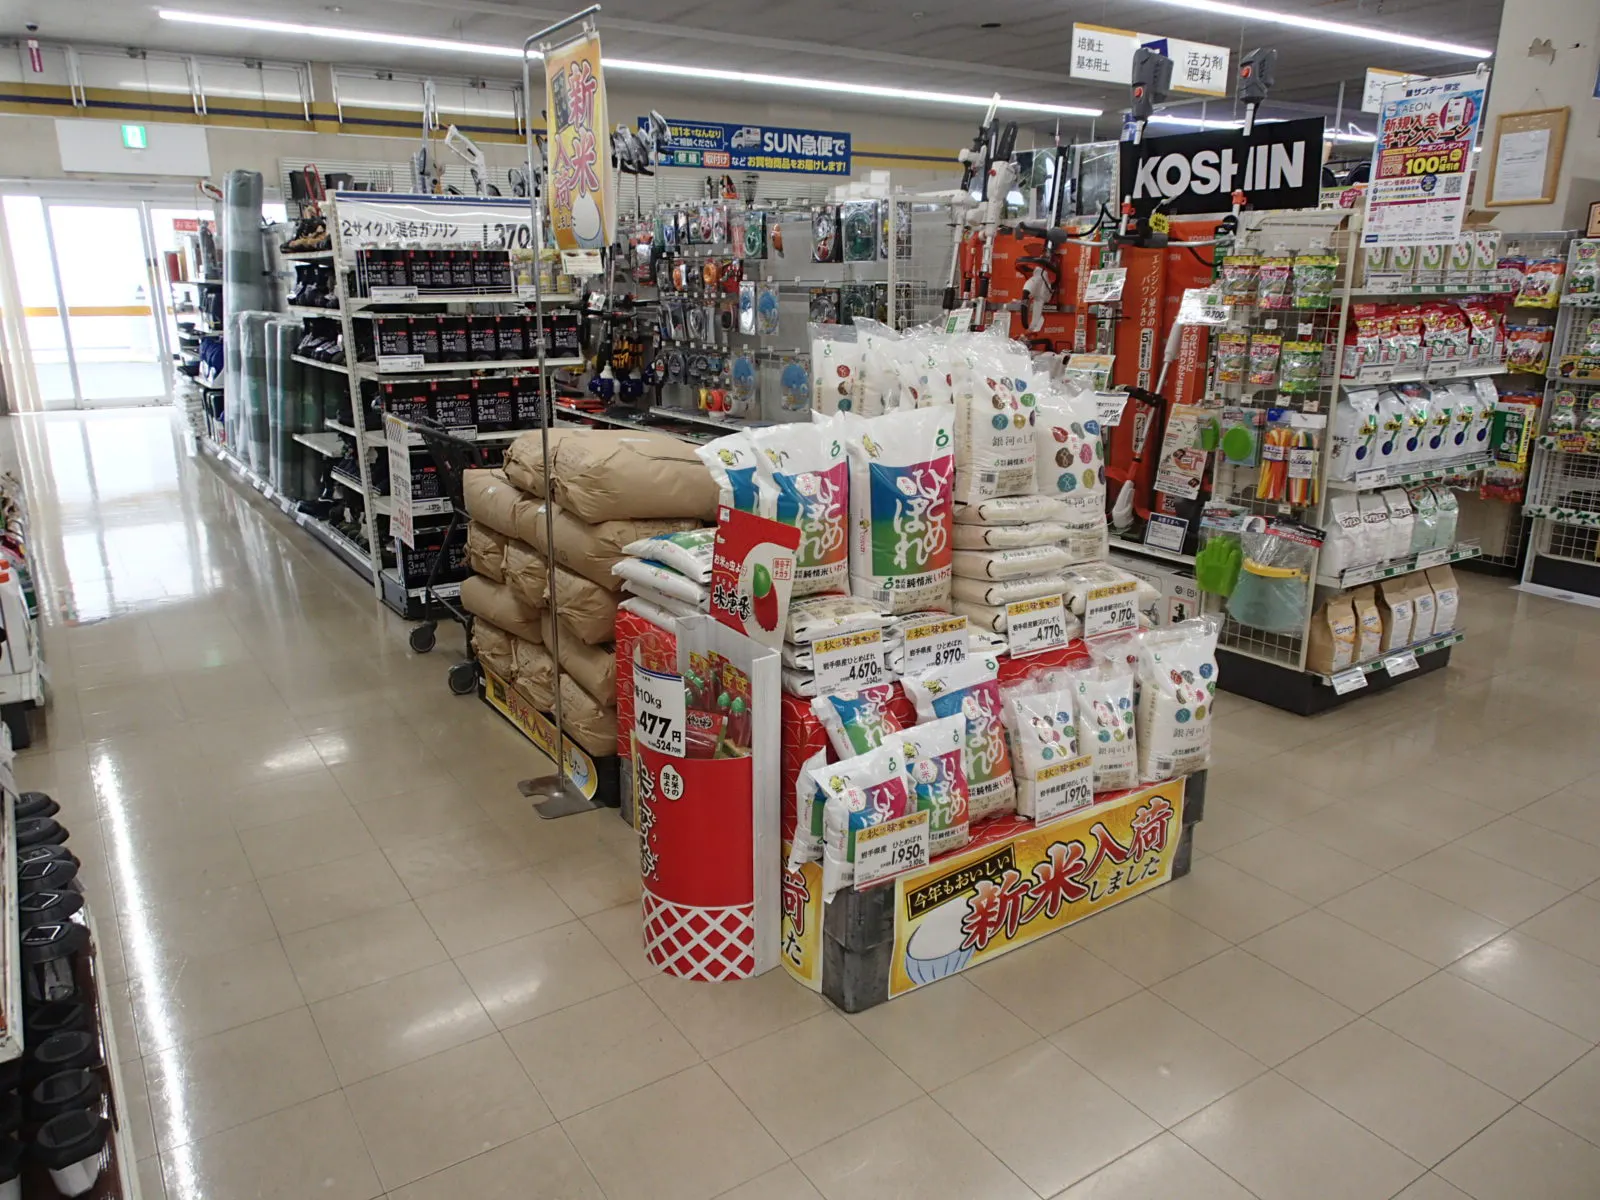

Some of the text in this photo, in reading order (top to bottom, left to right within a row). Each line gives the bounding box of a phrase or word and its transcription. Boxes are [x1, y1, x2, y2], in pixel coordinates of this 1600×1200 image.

[1078, 36, 1104, 53] 培養土
[1076, 56, 1110, 73] 基本用土
[1187, 52, 1223, 70] 活力剤
[1187, 68, 1212, 84] 肥料
[567, 59, 600, 197] 新米
[1384, 113, 1439, 132] 新規入会
[763, 132, 845, 157] SUN急便で
[1383, 125, 1472, 148] キャンペーン
[1133, 140, 1306, 200] KOSHIN
[343, 219, 459, 239] 2サイクル混合ガソリン
[1139, 277, 1151, 327] パワフルさ
[1147, 254, 1161, 327] エンジン並みの
[914, 468, 948, 556] ひとめ
[894, 498, 929, 569] ぼれ
[909, 639, 963, 657] 岩手県産 ひとめぼれ
[823, 653, 876, 671] 岩手県産ひとめぼれ
[662, 771, 672, 795] 虫よけ
[670, 773, 680, 797] お米の
[861, 834, 922, 859] 岩手県産 ひとめぼれ
[913, 855, 1012, 910] 今年もおいしい
[960, 795, 1175, 952] 新米入荷
[1089, 857, 1161, 904] しました
